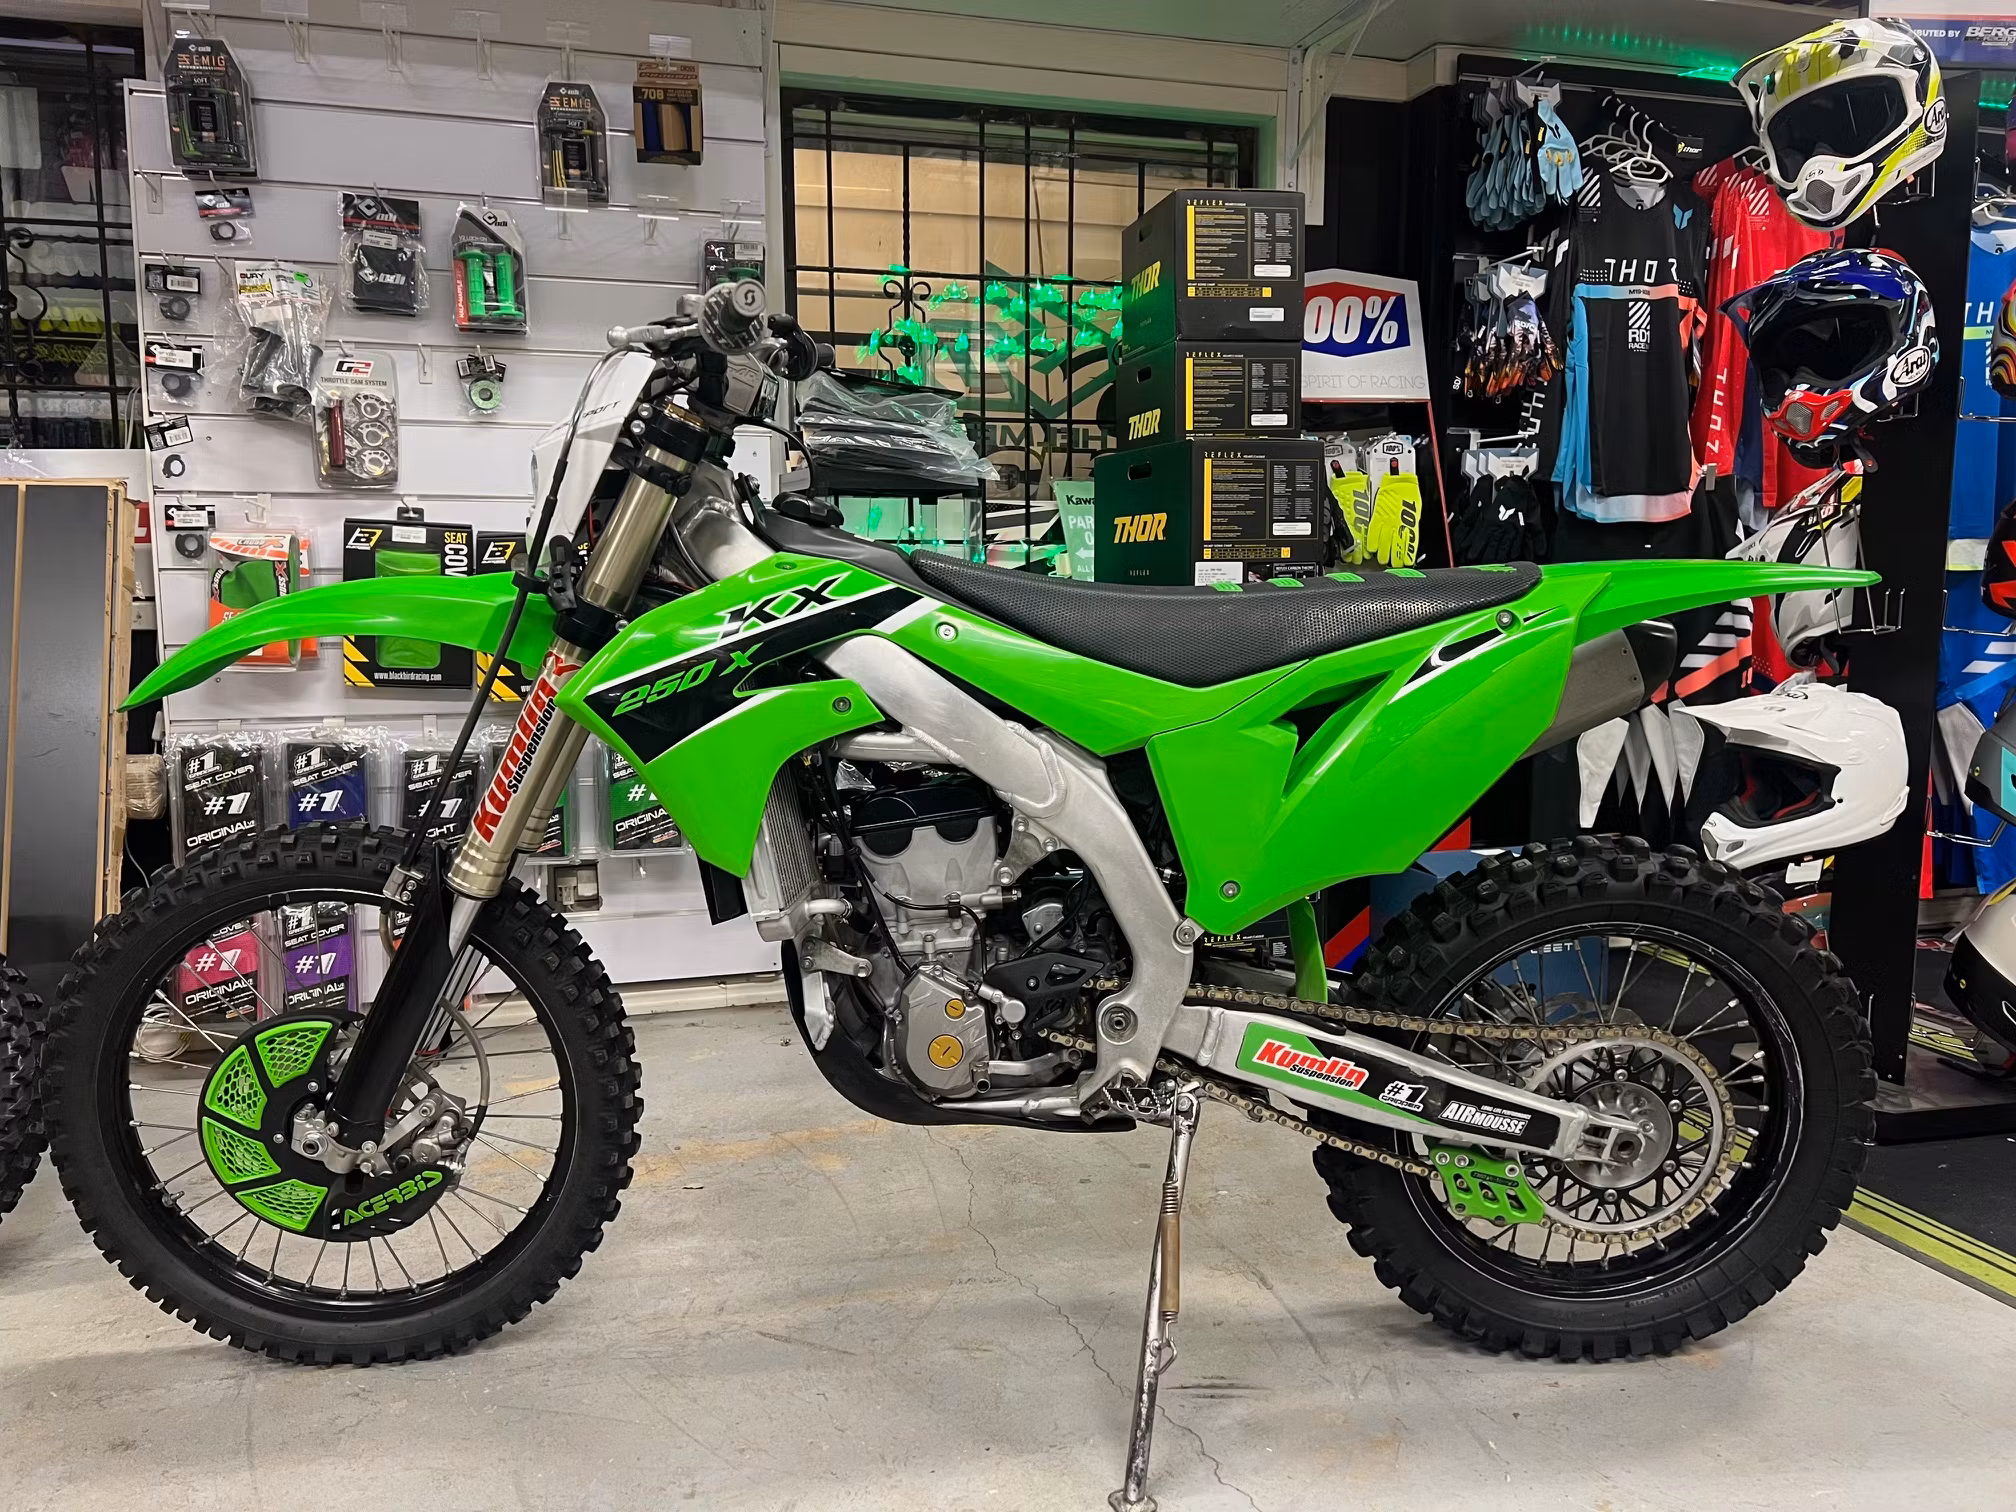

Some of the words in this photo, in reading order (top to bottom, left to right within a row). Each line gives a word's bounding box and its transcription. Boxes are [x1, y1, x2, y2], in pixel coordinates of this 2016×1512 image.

[641, 88, 664, 99] 708
[1130, 261, 1161, 302] THOR
[1303, 295, 1398, 344] 00%
[1895, 350, 1926, 381] Arai
[1303, 375, 1344, 389] SPIRIT
[1348, 375, 1367, 389] OF
[1370, 375, 1426, 389] RACING
[1128, 408, 1161, 440] THOR
[1066, 495, 1095, 505] Kawa
[1069, 516, 1095, 528] PAR
[1114, 513, 1166, 543] THOR
[445, 532, 467, 544] SEAT
[445, 544, 468, 577] COV
[717, 573, 852, 640] KX
[374, 671, 442, 683] www.blackbirdracing.com
[612, 659, 718, 717] 250
[719, 643, 763, 676] X
[296, 747, 321, 769] #1
[507, 697, 558, 795] Suspension
[188, 751, 215, 774] #1
[413, 755, 438, 774] #1
[472, 677, 558, 844] Kumlin
[185, 777, 213, 791] SEAT
[215, 764, 255, 781] COVER
[293, 773, 319, 787] SEAT
[321, 760, 358, 777] COVER
[408, 779, 434, 791] SEAT
[613, 768, 634, 779] SEA
[204, 792, 251, 815] #1
[298, 790, 343, 812] #1
[615, 808, 668, 832] ORIGINA
[285, 935, 309, 947] SEAT
[311, 923, 345, 939] COVER
[195, 949, 242, 972] #1
[295, 953, 337, 974] #1
[1256, 1042, 1366, 1087] Kumlin
[1290, 1064, 1354, 1088] Suspension
[1387, 1083, 1427, 1103] #1
[1441, 1102, 1526, 1134] AIRMOUSSE
